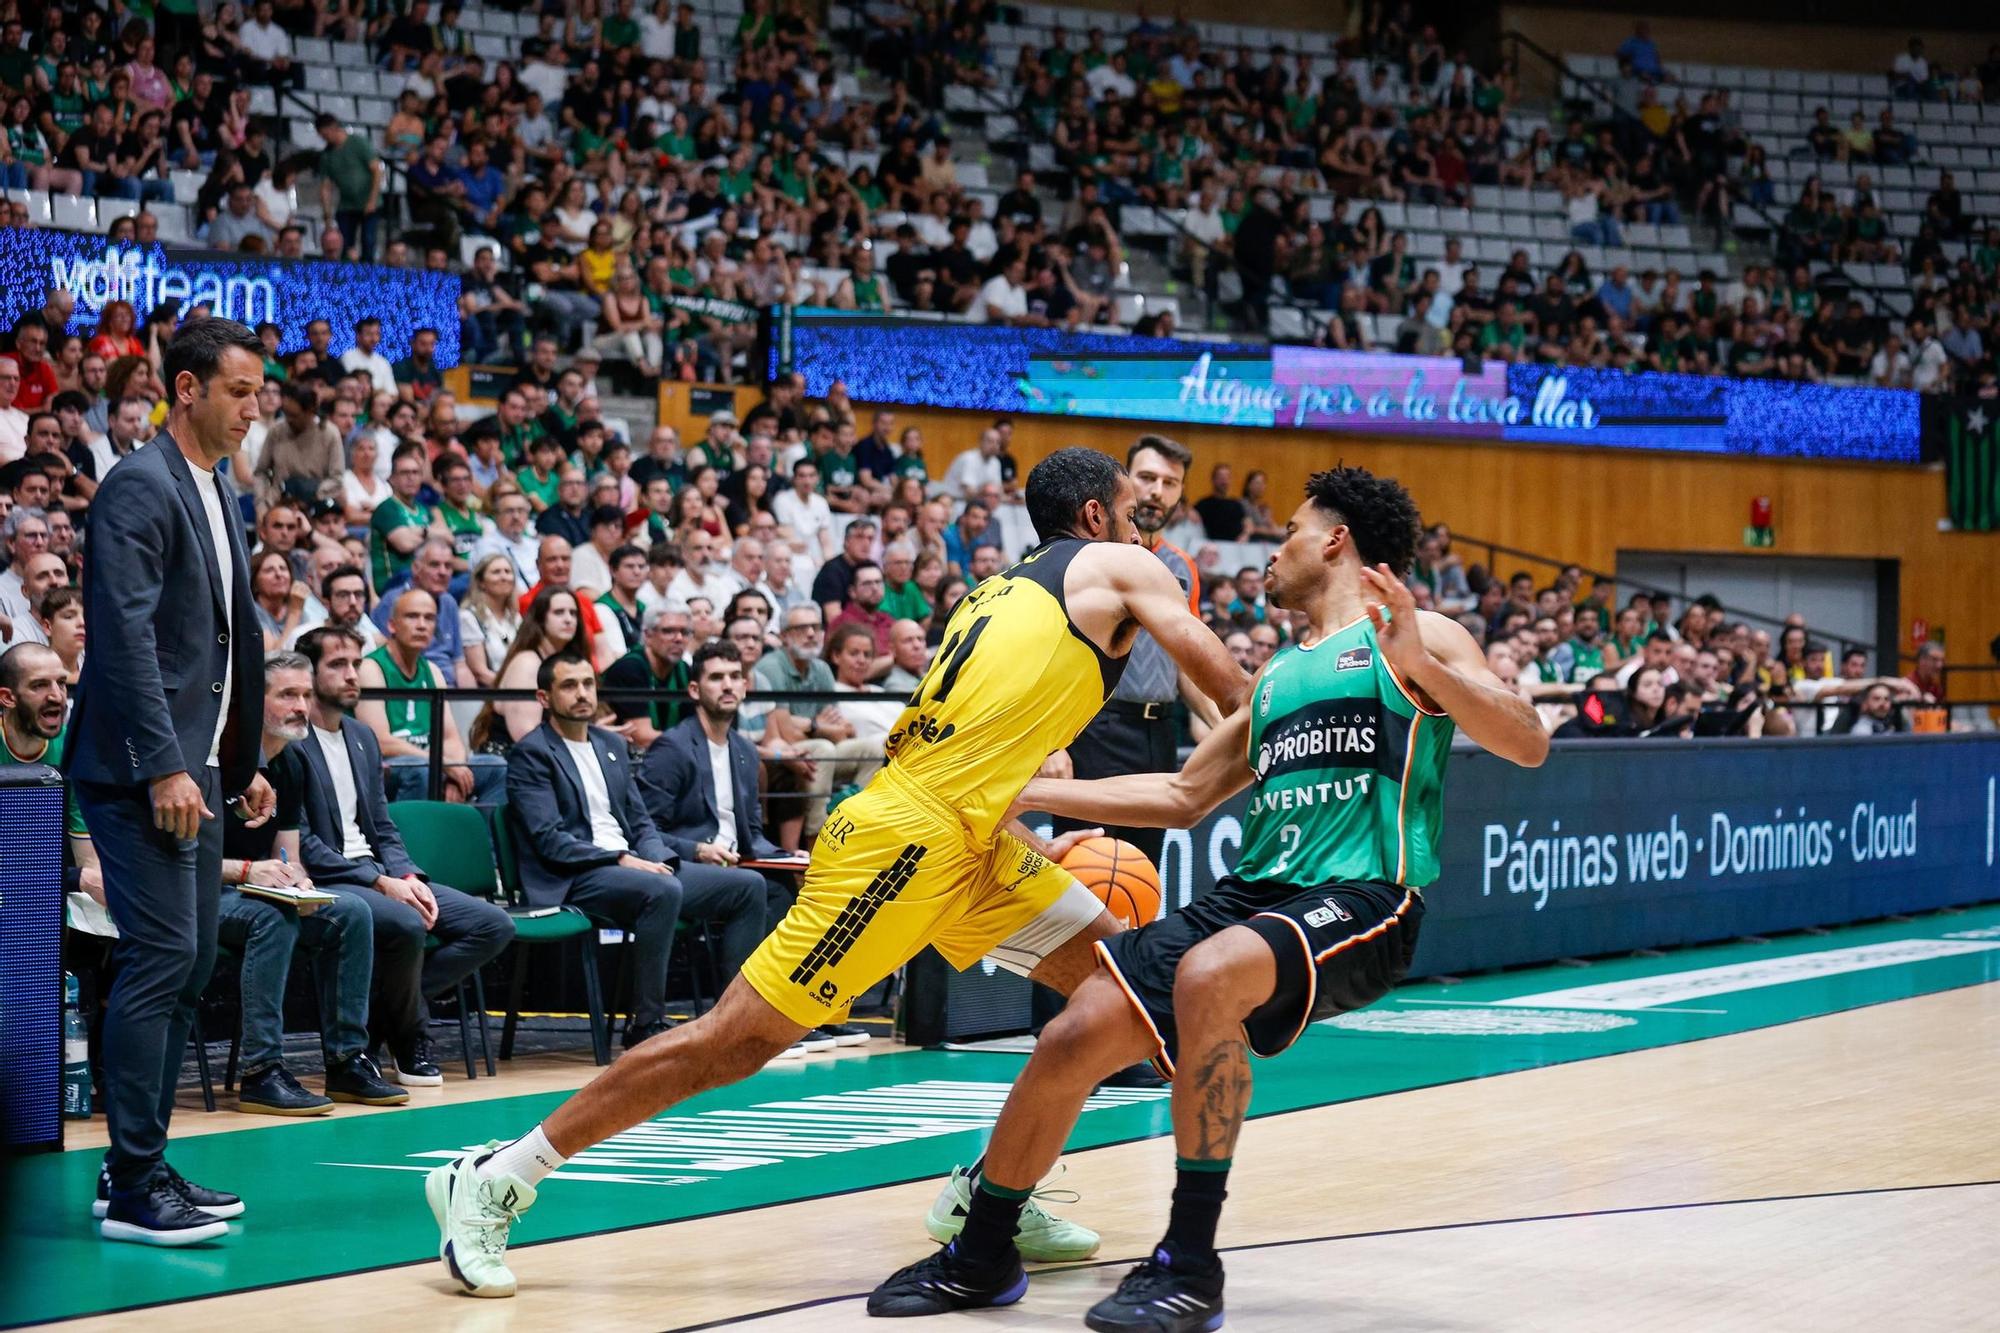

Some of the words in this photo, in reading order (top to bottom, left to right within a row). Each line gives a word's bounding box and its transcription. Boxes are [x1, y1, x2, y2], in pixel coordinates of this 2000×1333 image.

[1404, 369, 1440, 421] la
[1532, 376, 1599, 429] llar
[1271, 727, 1376, 766] PROBITAS
[1276, 714, 1377, 741] FUNDACIÓN
[1484, 820, 1618, 911] Páginas
[1627, 814, 1689, 883] web
[1710, 807, 1834, 876] Dominios
[1851, 800, 1918, 862] Cloud
